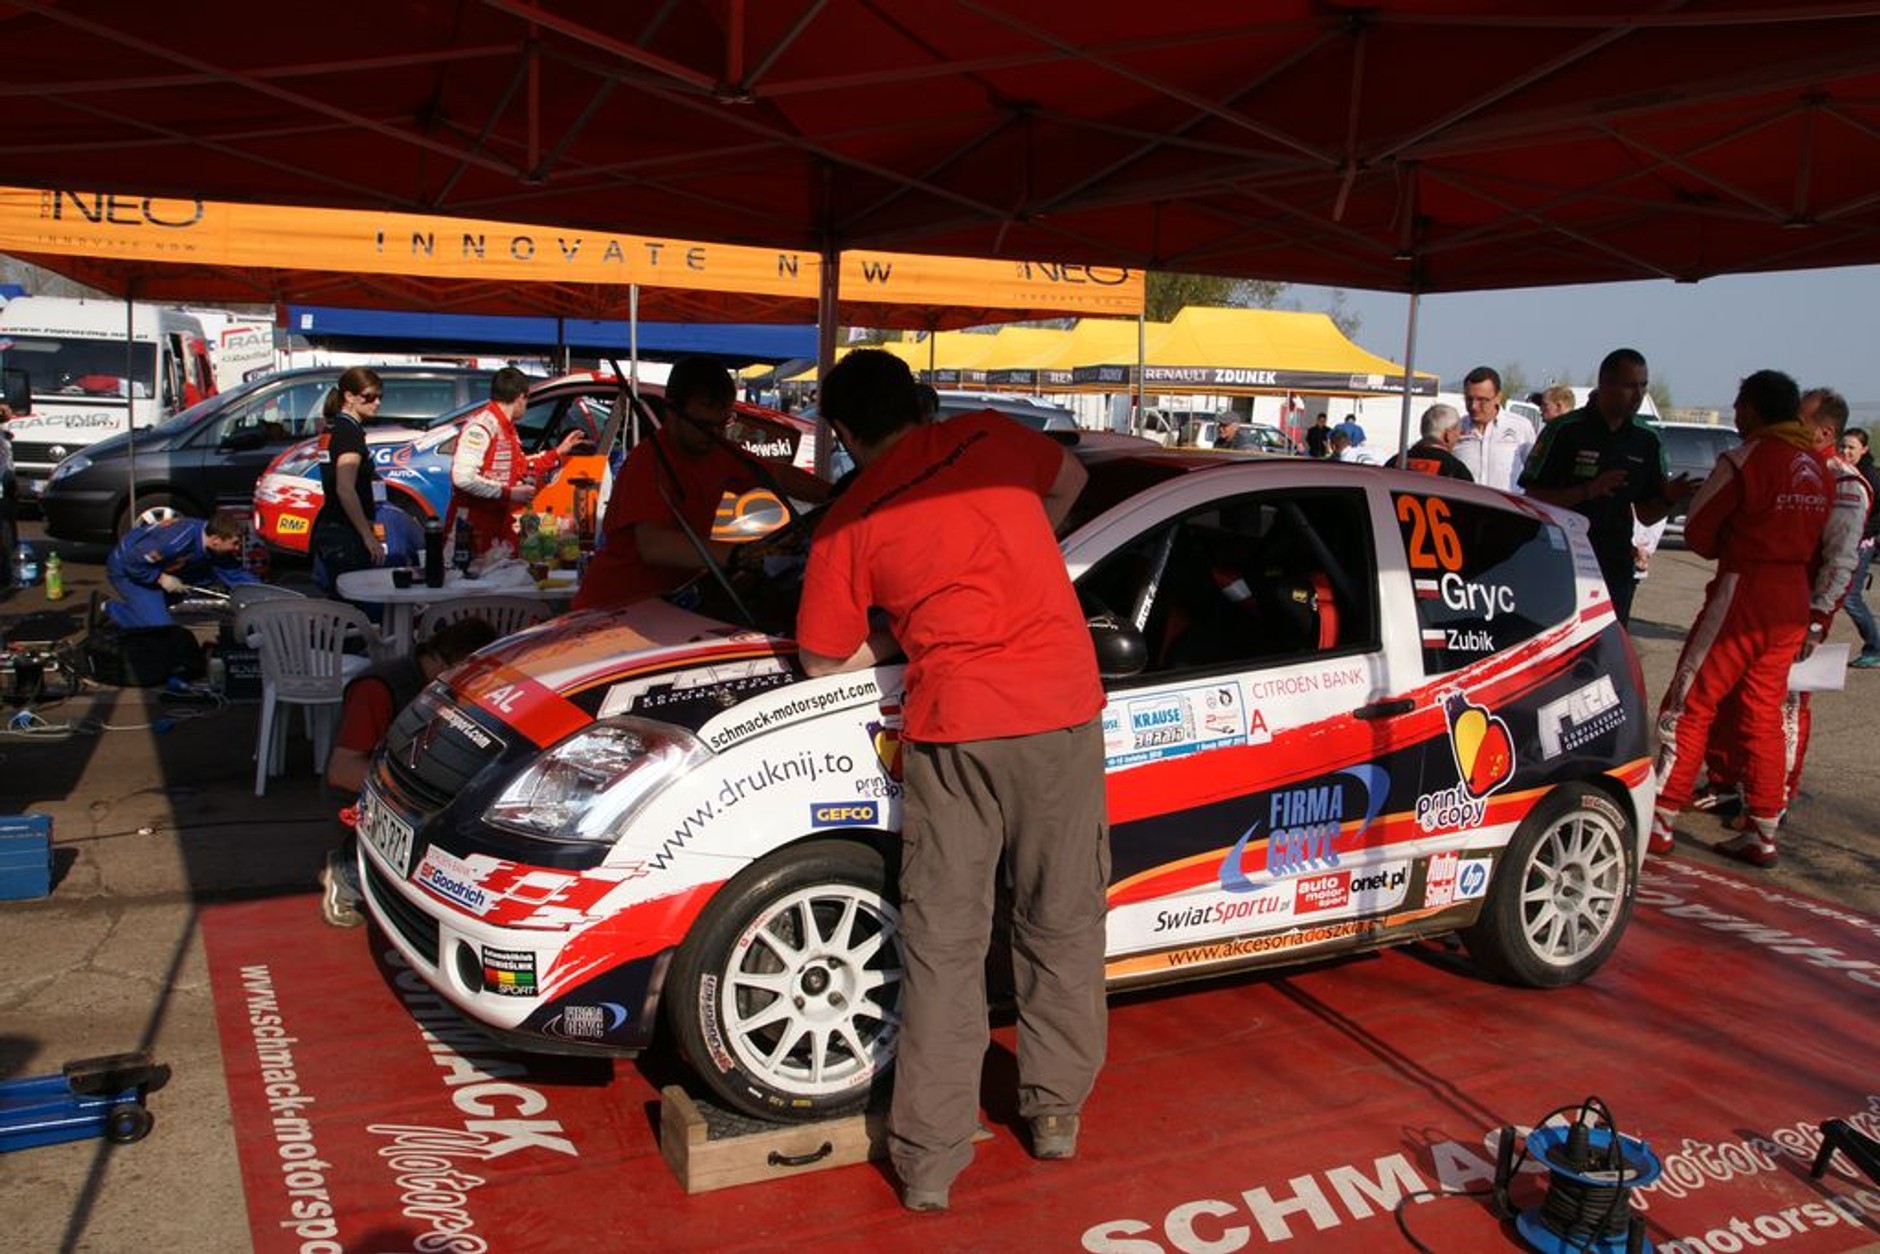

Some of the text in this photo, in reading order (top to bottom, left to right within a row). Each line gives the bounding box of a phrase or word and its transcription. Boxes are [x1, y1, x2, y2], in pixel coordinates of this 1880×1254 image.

[375, 229, 893, 284] INNOVATE NW
[1145, 367, 1278, 385] RENAULT ZDUNEK
[279, 516, 308, 532] RMF
[1396, 494, 1463, 572] 26
[1441, 572, 1515, 622] Gryc
[1446, 628, 1496, 652] Zubik
[1321, 667, 1365, 690] BANK
[711, 678, 878, 750] schmack-motorsport.com
[1132, 708, 1181, 729] KRAUSE
[1250, 708, 1269, 736] A
[648, 751, 854, 872] www.druknij.to
[816, 805, 874, 822] GEFCO
[1269, 784, 1344, 829] FIRMA
[1436, 799, 1485, 826] copy
[1265, 820, 1342, 878] GRYC
[1298, 876, 1340, 894] auto
[1305, 888, 1346, 902] motor
[499, 984, 535, 996] SPORT
[564, 1005, 604, 1021] FIRMA
